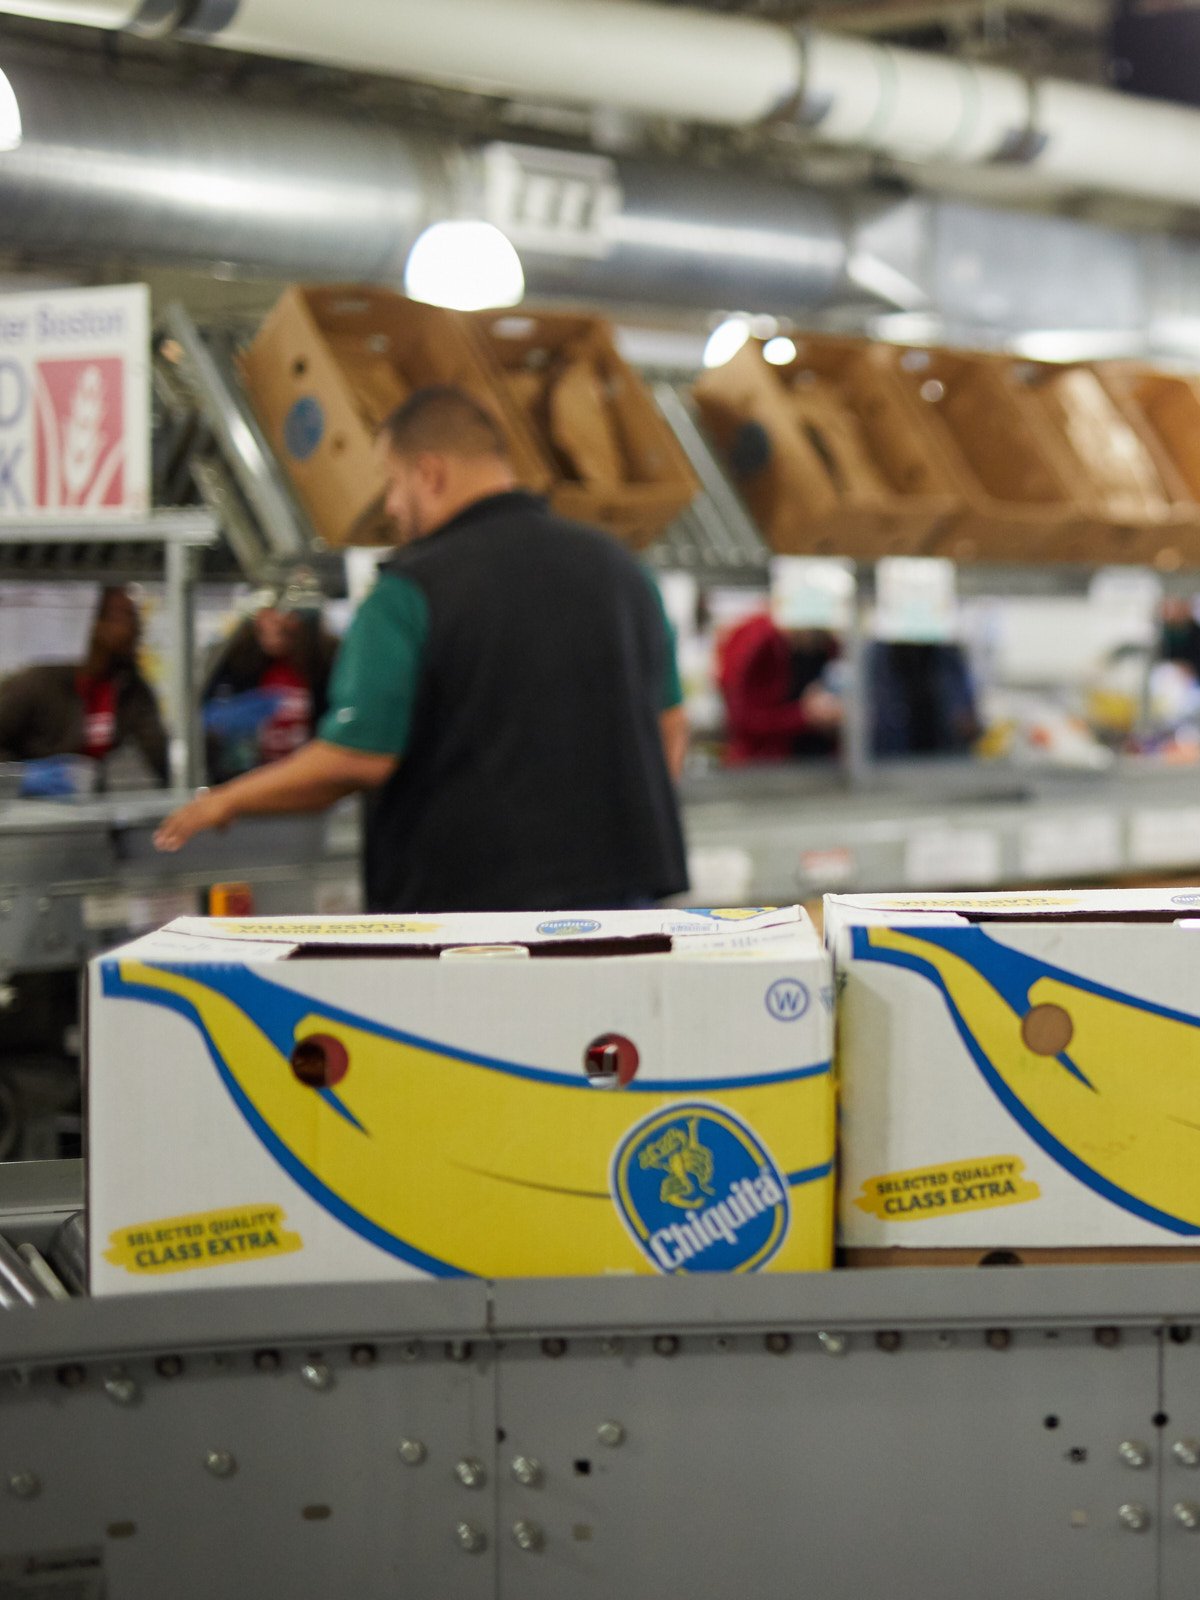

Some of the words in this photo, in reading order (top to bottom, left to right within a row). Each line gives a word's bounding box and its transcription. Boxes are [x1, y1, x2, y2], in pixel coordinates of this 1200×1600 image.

[876, 1172, 948, 1195] SELECTED
[952, 1161, 1016, 1184] QUALITY
[883, 1190, 946, 1214] CLASS
[951, 1179, 1016, 1204] EXTRA
[127, 1223, 204, 1247] SELECTED
[209, 1211, 276, 1235] QUALITY
[650, 1173, 784, 1270] Chiquita
[135, 1241, 202, 1268] CLASS
[207, 1229, 278, 1256] EXTRA
